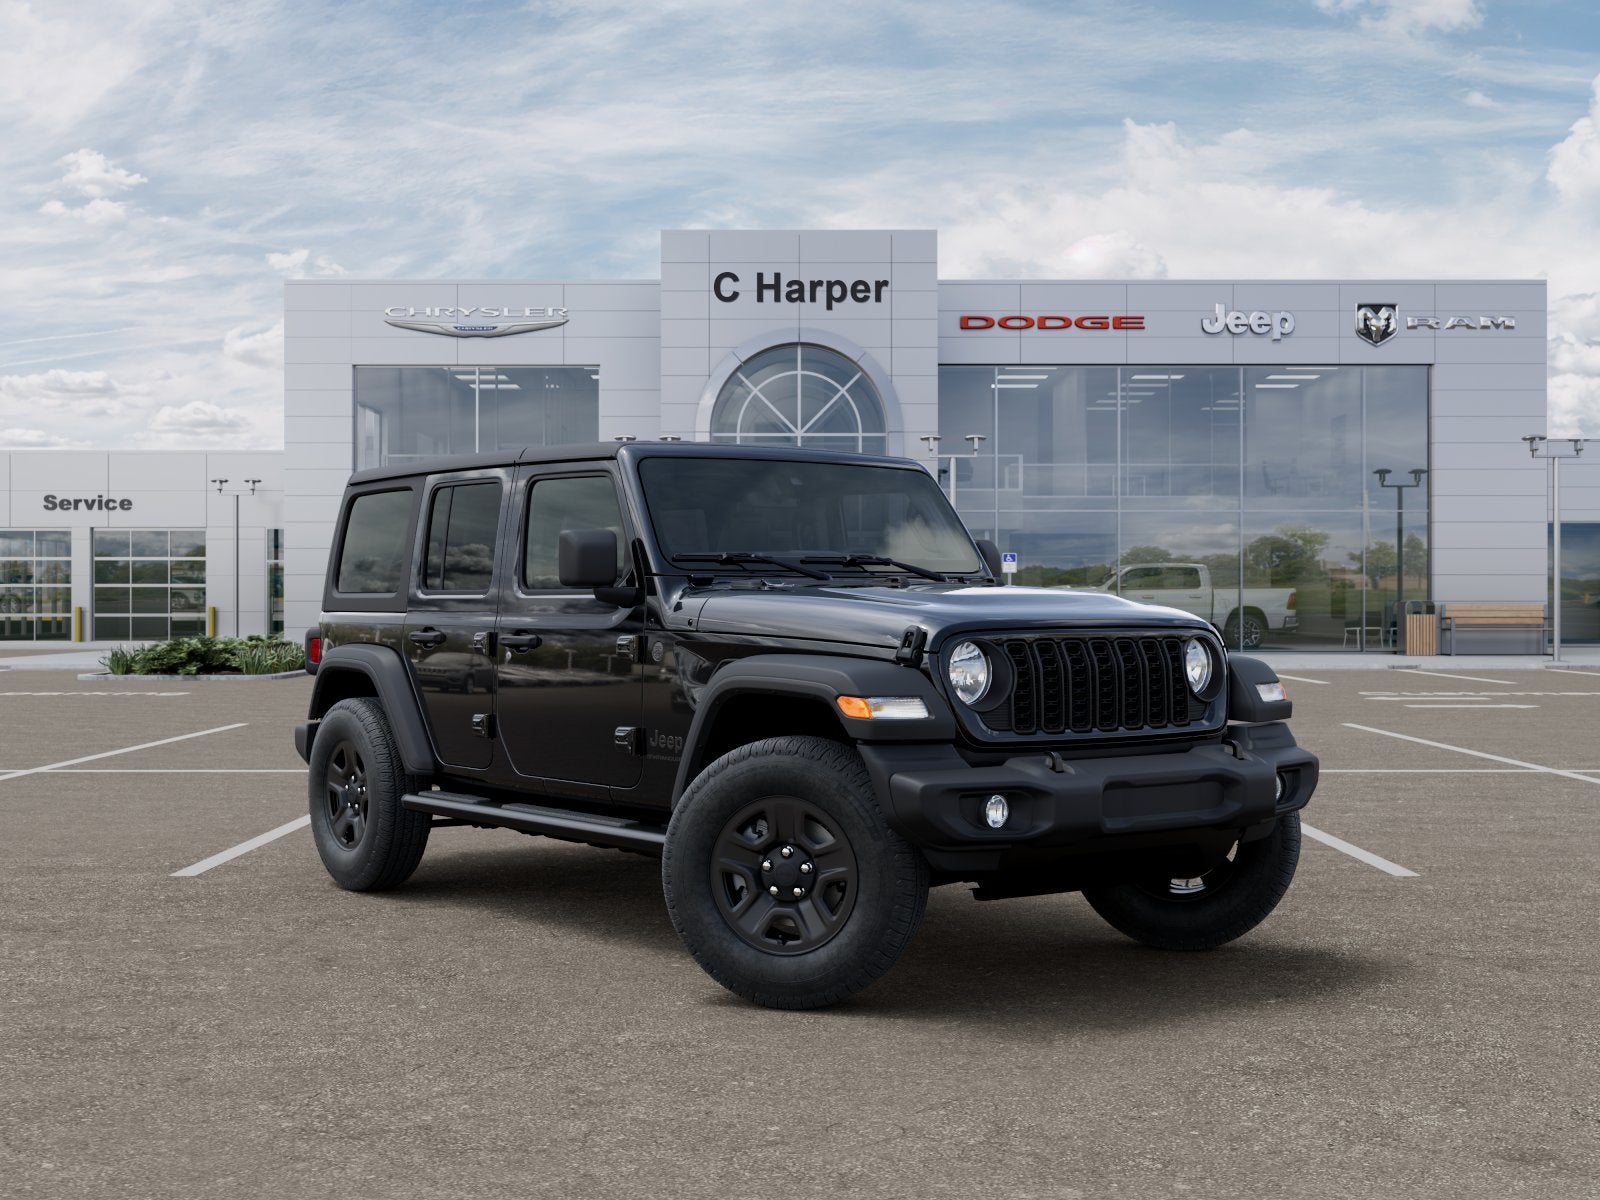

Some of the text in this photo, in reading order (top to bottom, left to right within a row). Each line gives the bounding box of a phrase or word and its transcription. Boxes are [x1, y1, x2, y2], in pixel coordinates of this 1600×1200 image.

[713, 271, 890, 311] C Harper
[384, 306, 568, 318] CHRYSLER
[959, 315, 1146, 330] DODGE
[1201, 303, 1295, 341] Jeep
[1406, 316, 1516, 330] RAM
[43, 494, 133, 511] Service
[650, 729, 683, 753] Jeep
